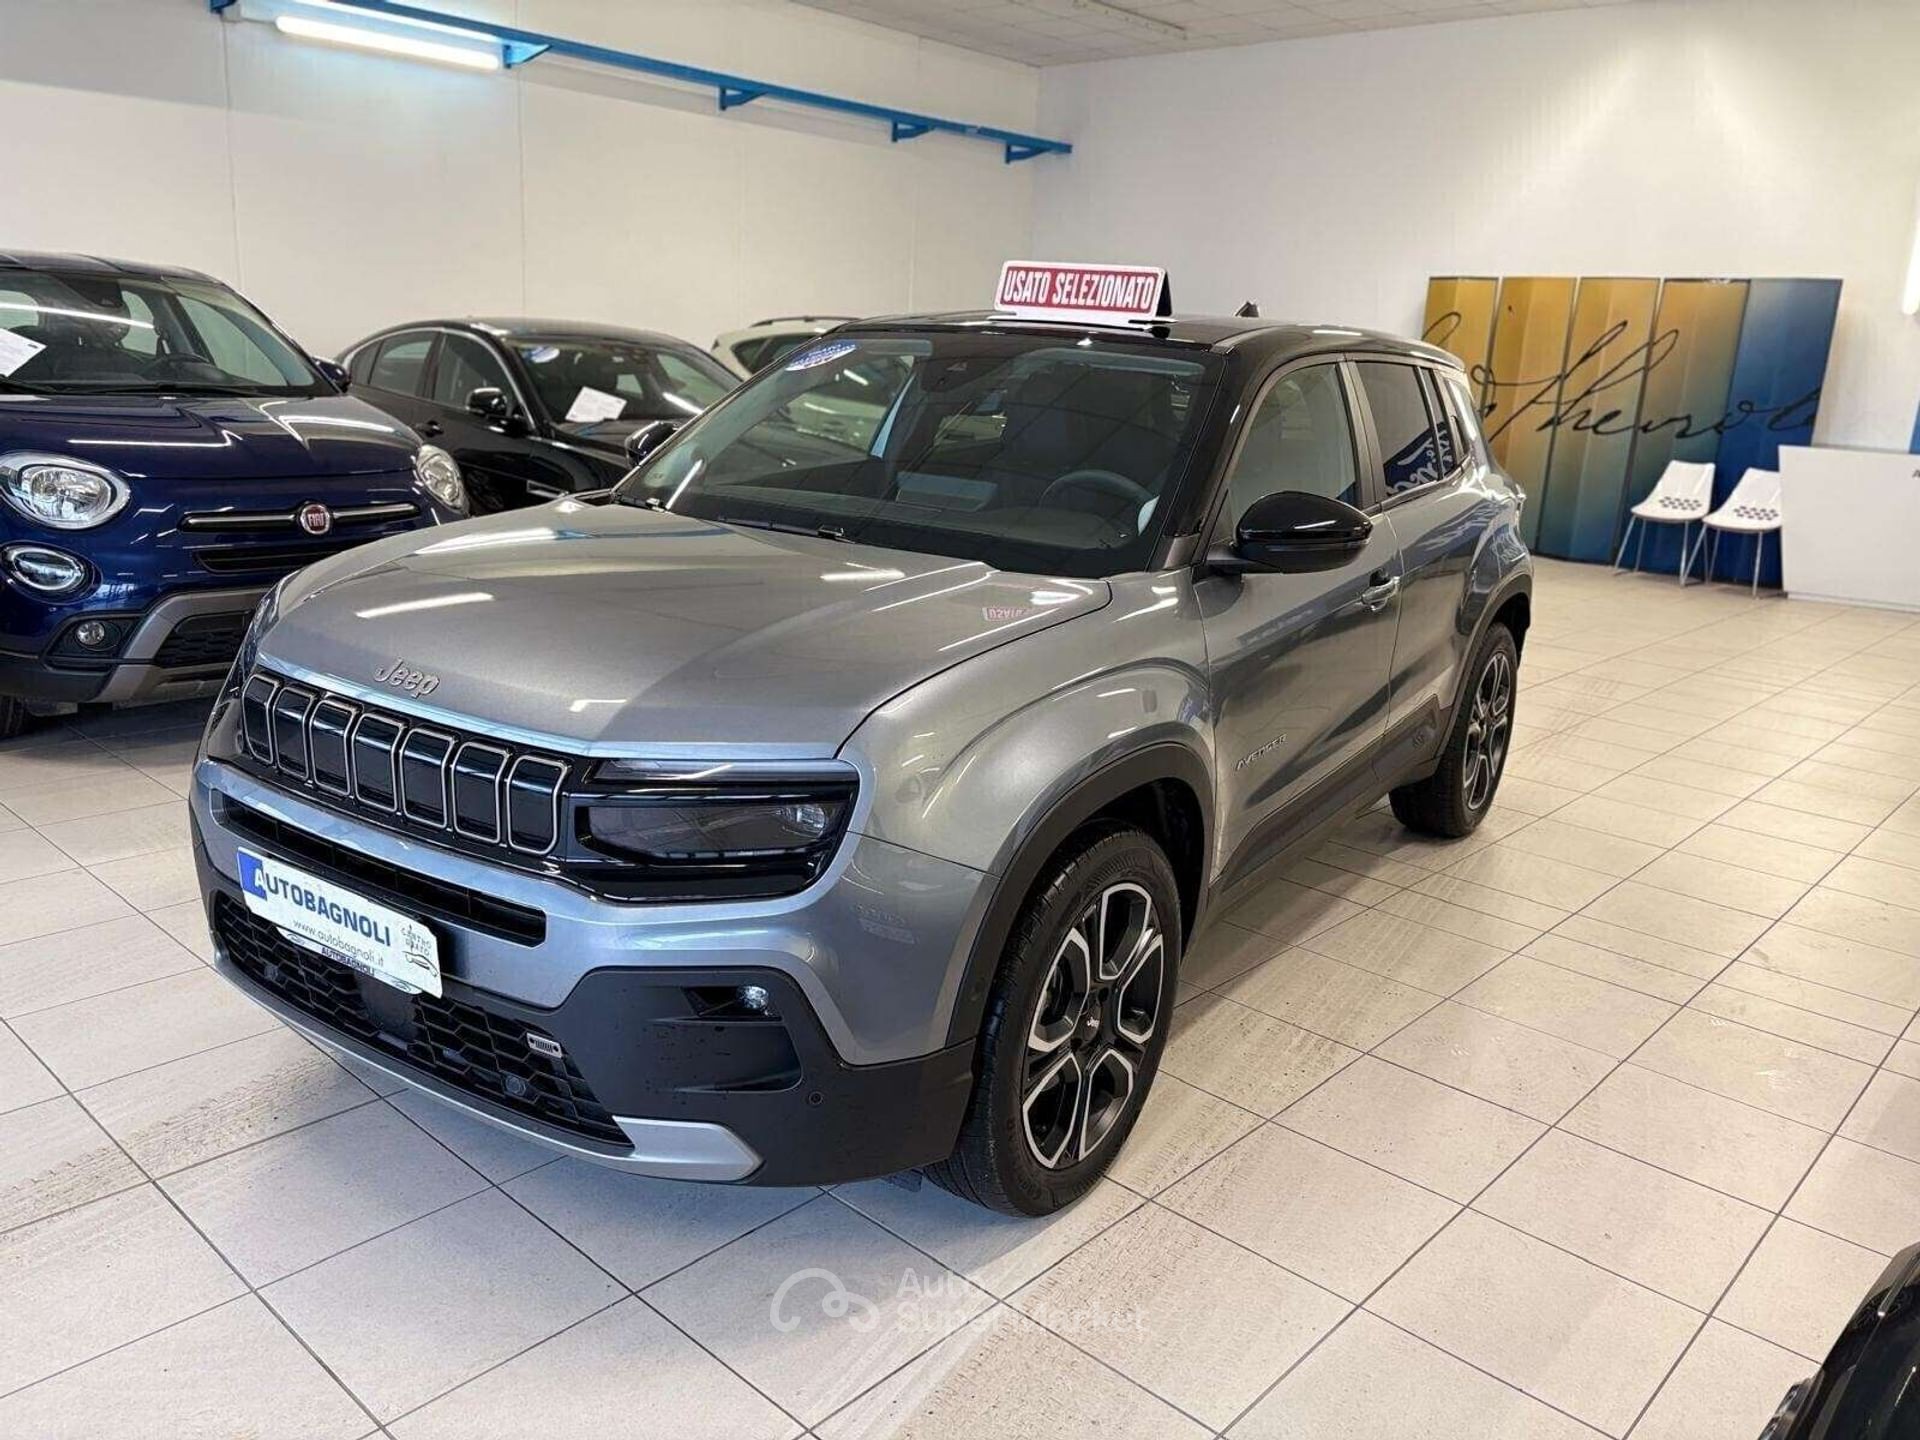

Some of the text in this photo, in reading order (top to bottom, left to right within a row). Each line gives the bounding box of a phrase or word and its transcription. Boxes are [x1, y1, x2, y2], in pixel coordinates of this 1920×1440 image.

[1003, 270, 1156, 310] USATO SELEZIONATO
[308, 513, 324, 527] FIAT
[374, 658, 440, 699] Jeep
[1236, 733, 1288, 771] AVENGER
[254, 867, 392, 947] AUTOBAGNOLI
[293, 919, 385, 967] www.autobagnoli.it
[321, 946, 375, 977] AUTOBAGNOLI
